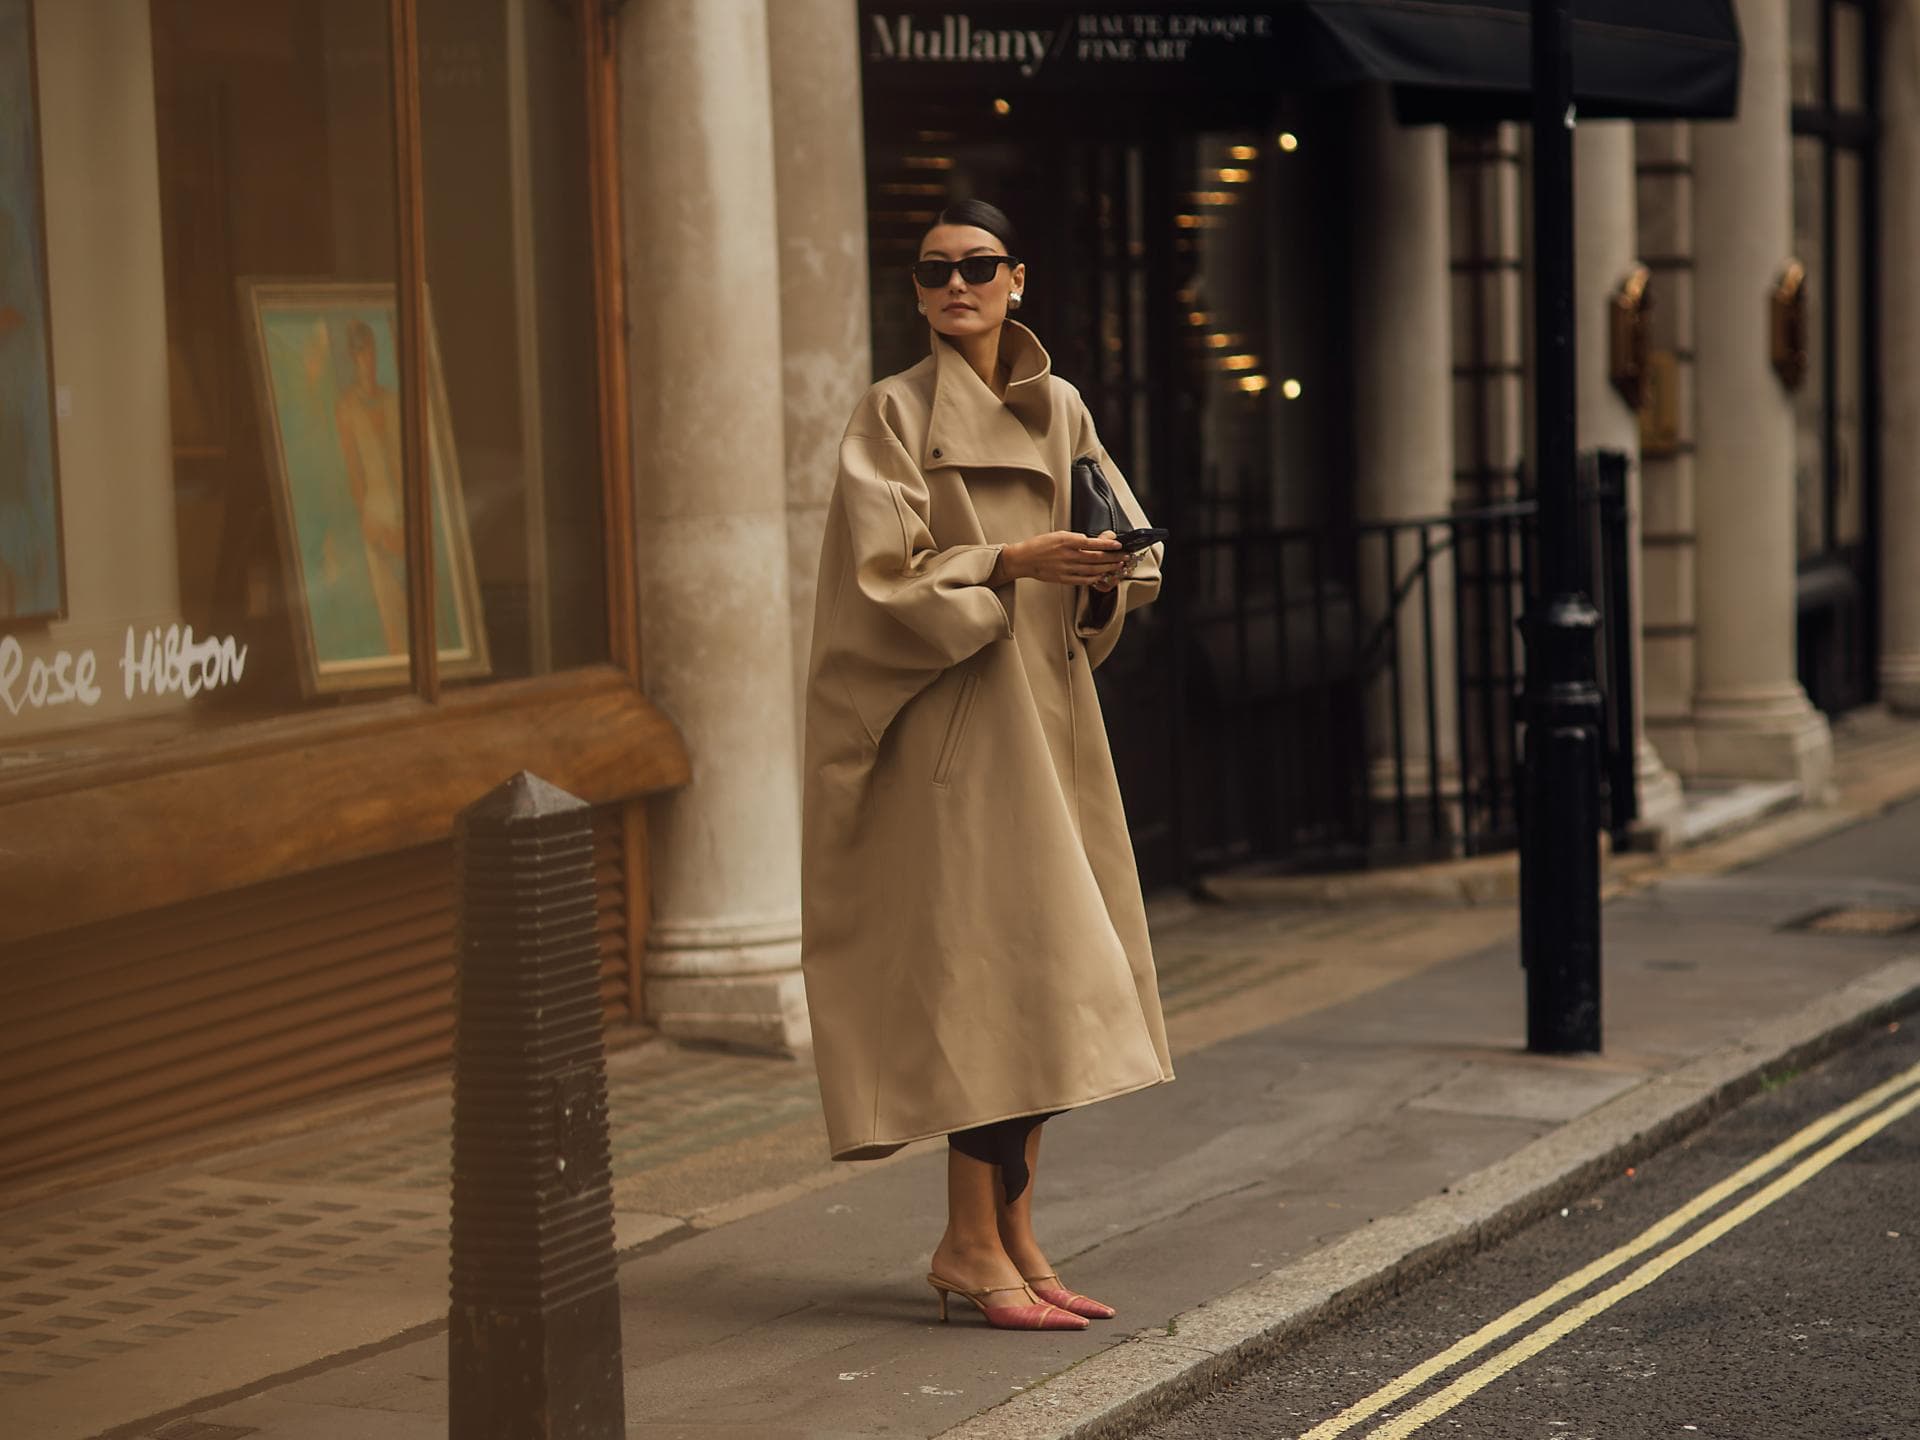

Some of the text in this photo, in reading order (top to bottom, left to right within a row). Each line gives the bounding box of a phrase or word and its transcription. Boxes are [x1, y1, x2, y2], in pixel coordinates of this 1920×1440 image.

[1077, 38, 1191, 61] FINE ART
[0, 623, 248, 715] Rose Hilton
